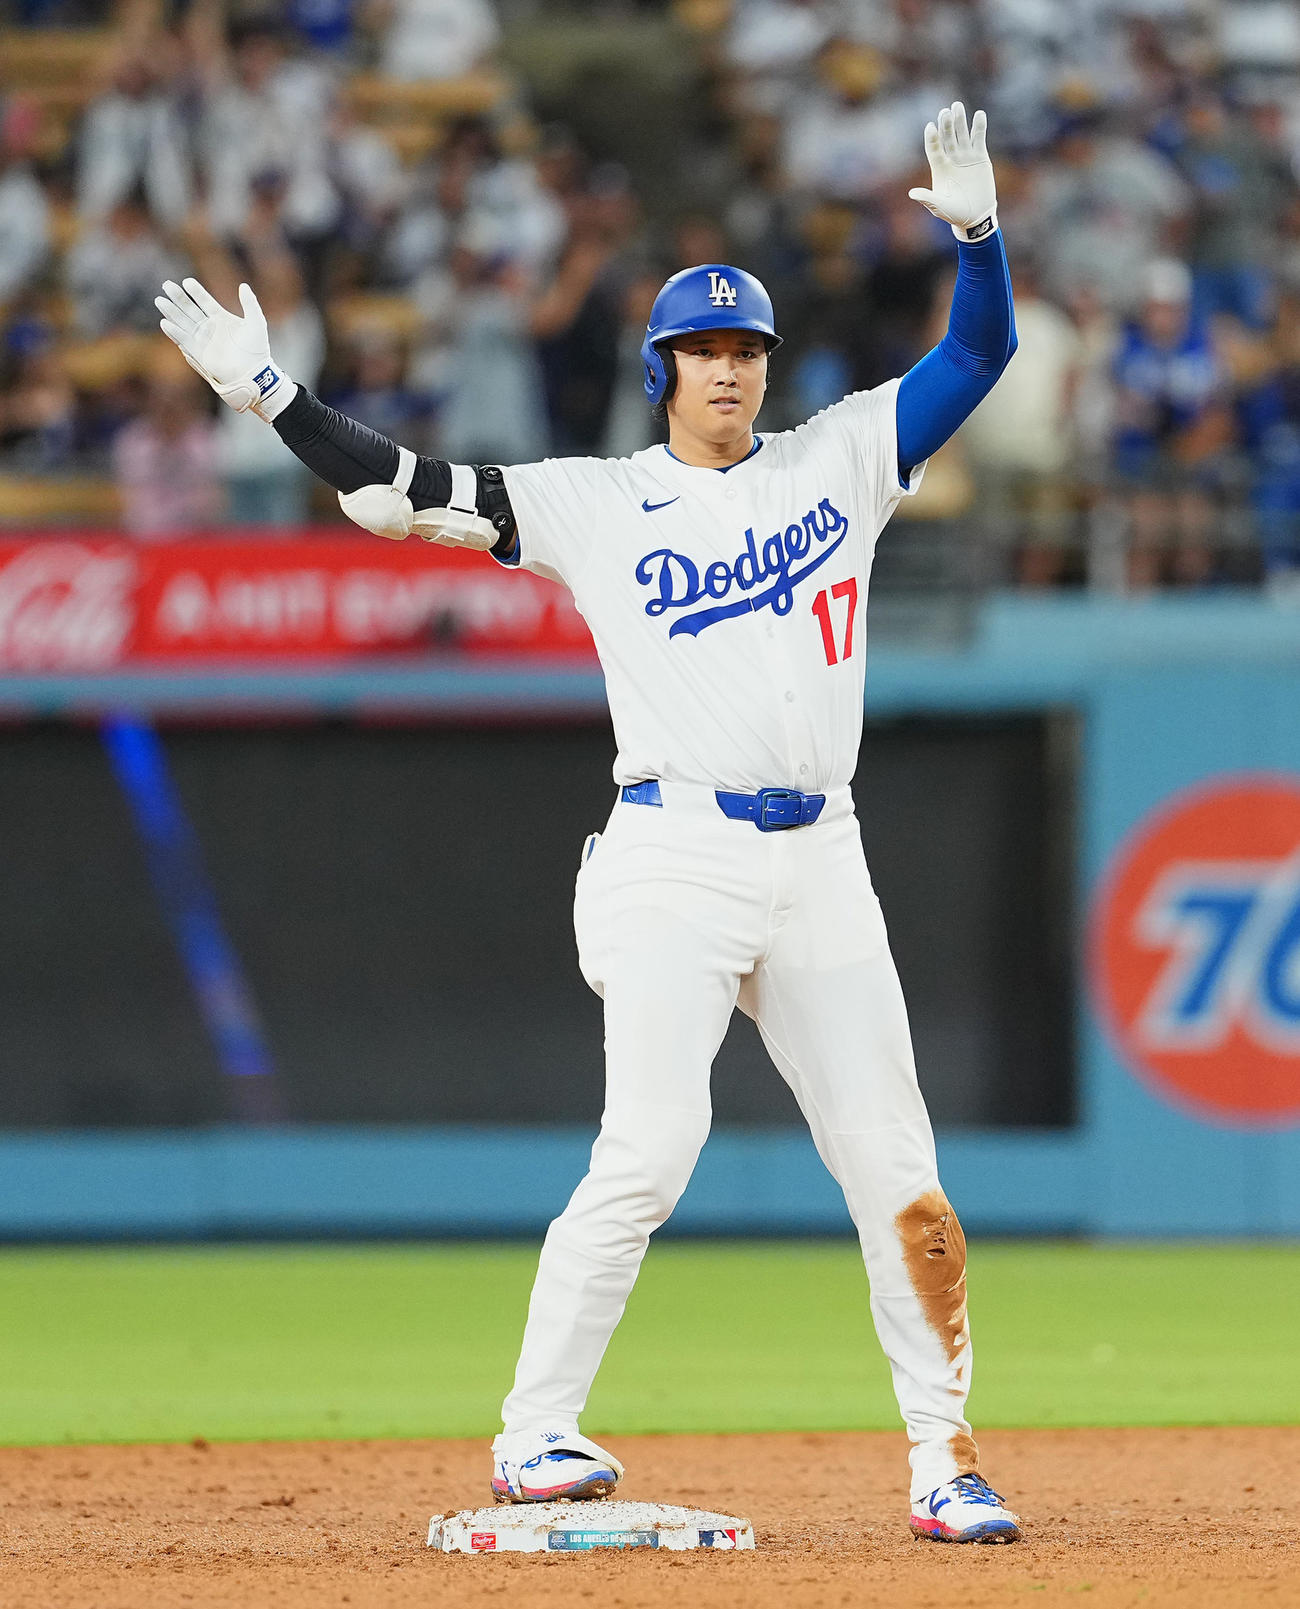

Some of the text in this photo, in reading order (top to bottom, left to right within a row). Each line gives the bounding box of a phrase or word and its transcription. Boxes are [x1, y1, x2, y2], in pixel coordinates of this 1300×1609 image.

[707, 272, 737, 306] LA
[636, 498, 848, 640] Dodgers
[811, 577, 858, 666] 17
